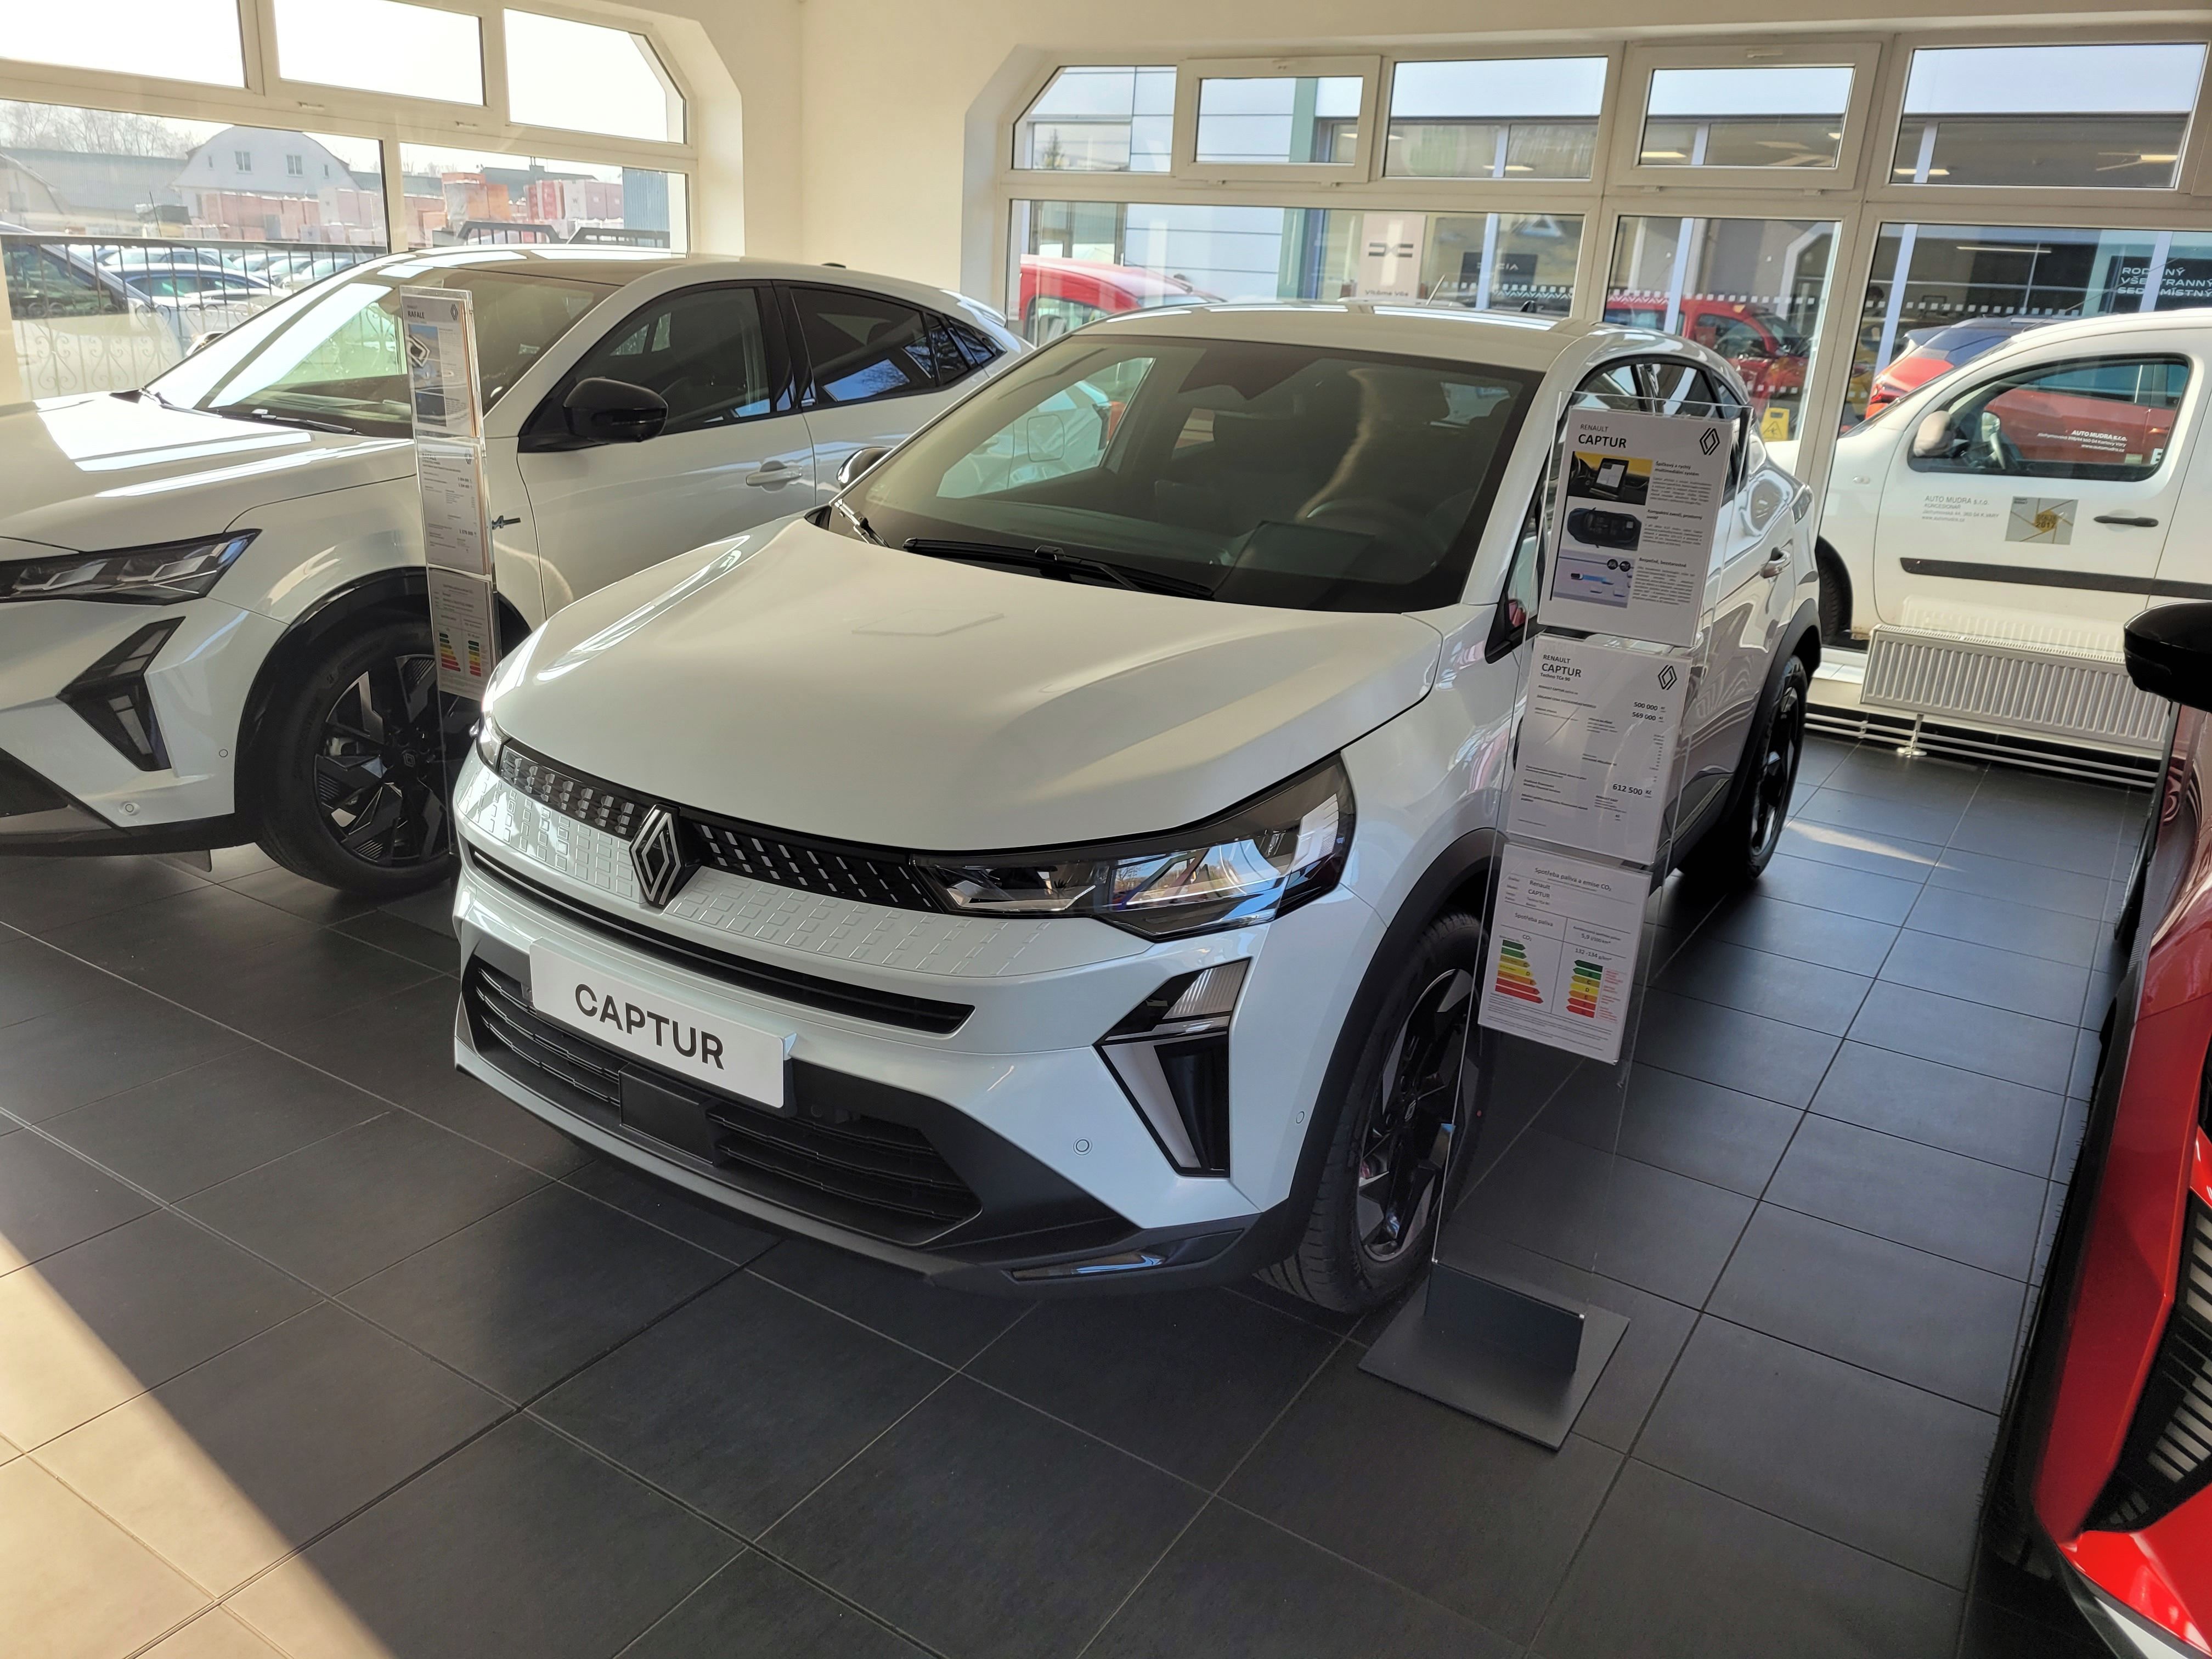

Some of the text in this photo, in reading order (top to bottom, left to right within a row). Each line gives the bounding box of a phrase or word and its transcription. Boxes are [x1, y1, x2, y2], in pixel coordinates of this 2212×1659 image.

[2122, 267, 2186, 276] RODNÝ
[2120, 275, 2212, 287] VŠETRANNÝ
[2118, 287, 2212, 297] SEDMÍSTNÝ
[408, 311, 425, 319] RAFALE
[1580, 424, 1609, 432] RENAULT
[1578, 434, 1627, 448] CAPTUR
[2090, 432, 2112, 440] MUDRA
[1543, 654, 1571, 664] RENAULT
[1542, 663, 1581, 678] CAPTUR
[1612, 783, 1627, 792] 612
[1628, 787, 1643, 795] 500
[1535, 867, 1560, 878] Spotřeba
[1560, 874, 1577, 883] paliva
[1583, 879, 1600, 888] emise
[1530, 879, 1550, 890] Renault
[1528, 889, 1550, 899] CAPTUR
[1515, 912, 1553, 927] Spotřeba paliva
[574, 983, 725, 1070] CAPTUR
